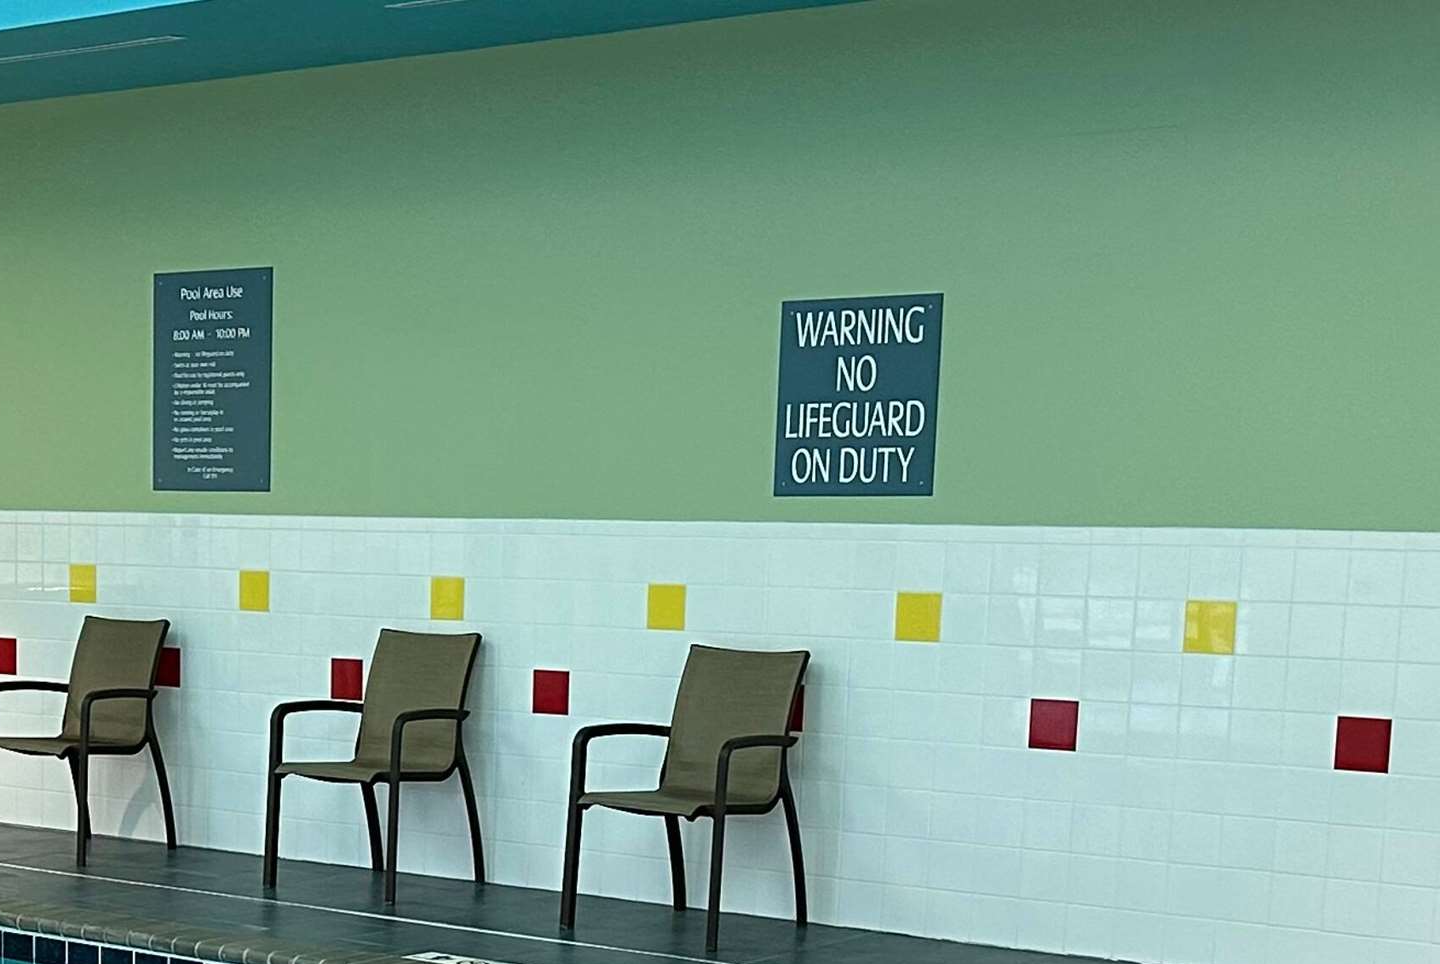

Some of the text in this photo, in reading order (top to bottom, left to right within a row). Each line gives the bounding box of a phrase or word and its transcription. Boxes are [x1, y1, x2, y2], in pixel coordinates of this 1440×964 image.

[180, 285, 243, 300] Pool Area Use
[189, 309, 207, 321] Pool
[796, 306, 925, 347] WARNING
[173, 330, 190, 341] 8:00
[191, 329, 205, 340] AM
[216, 328, 236, 339] 10:00
[238, 327, 250, 338] PM
[836, 355, 877, 392] NO
[785, 400, 925, 438] LIFEGUARD
[791, 447, 915, 483] ON DUTY
